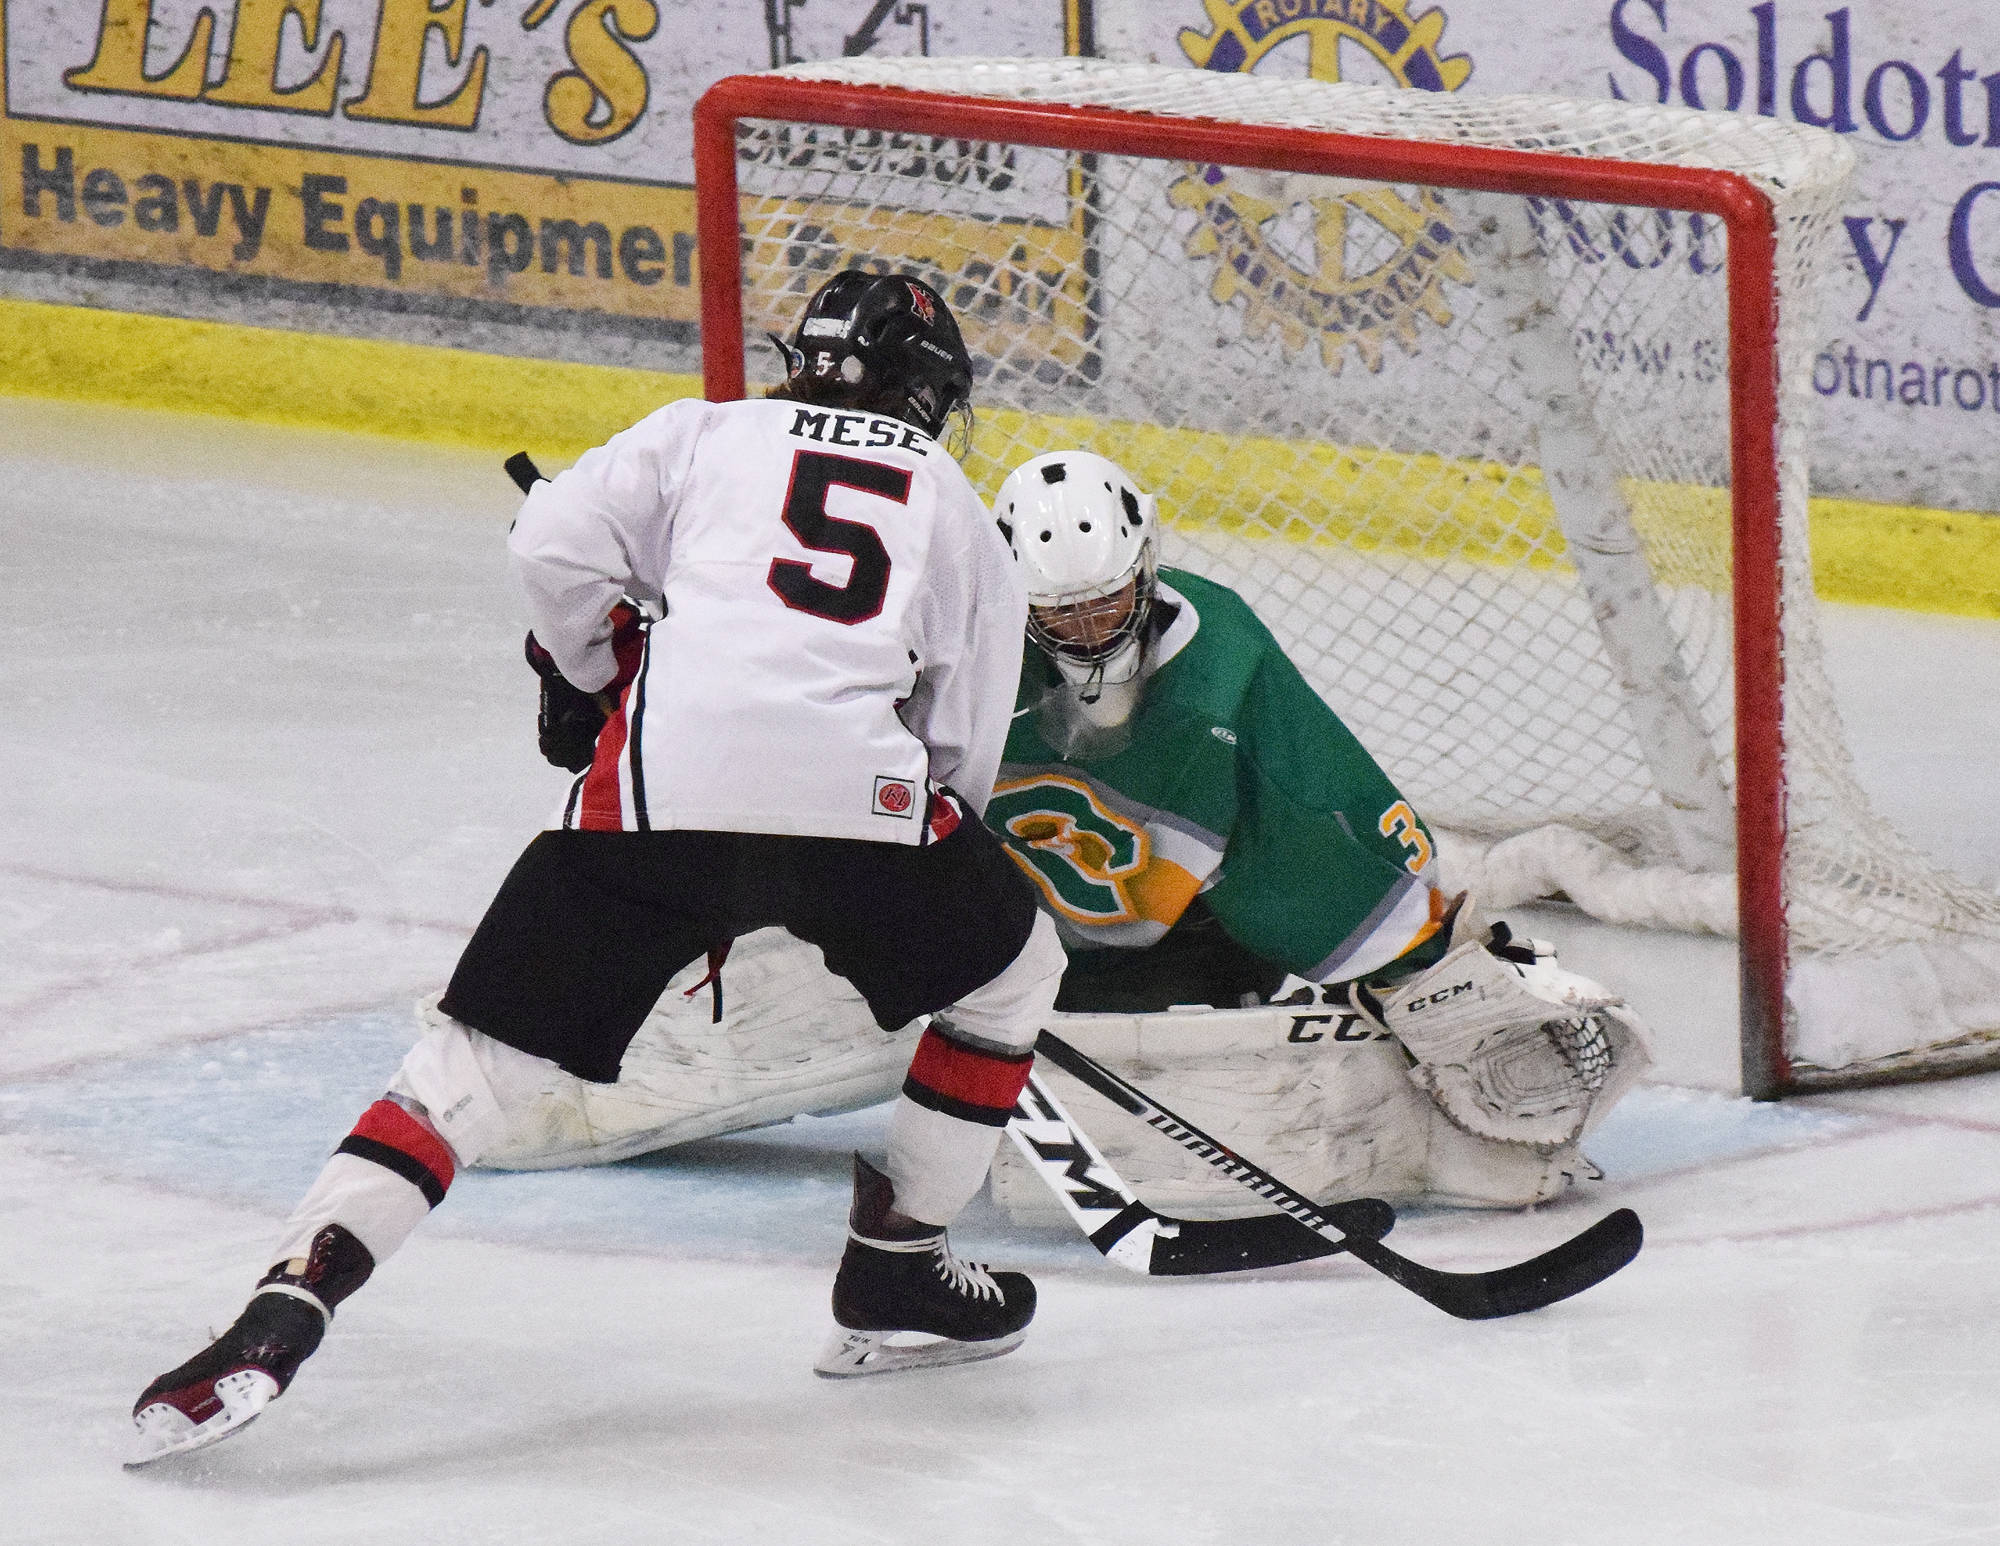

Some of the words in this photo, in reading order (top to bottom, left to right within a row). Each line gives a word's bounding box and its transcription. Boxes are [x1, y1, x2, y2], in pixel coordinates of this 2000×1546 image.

[20, 143, 271, 262] Heavy
[301, 173, 698, 288] Equipmen
[1525, 192, 1907, 322] Roty
[815, 351, 836, 376] 5
[920, 341, 953, 361] BAUER
[907, 396, 932, 424] BAUER
[788, 408, 932, 457] MESE
[766, 449, 914, 627] 5
[1407, 980, 1474, 1013] CCM
[1287, 1013, 1392, 1044] CC
[1146, 1113, 1334, 1233] WARRIOR
